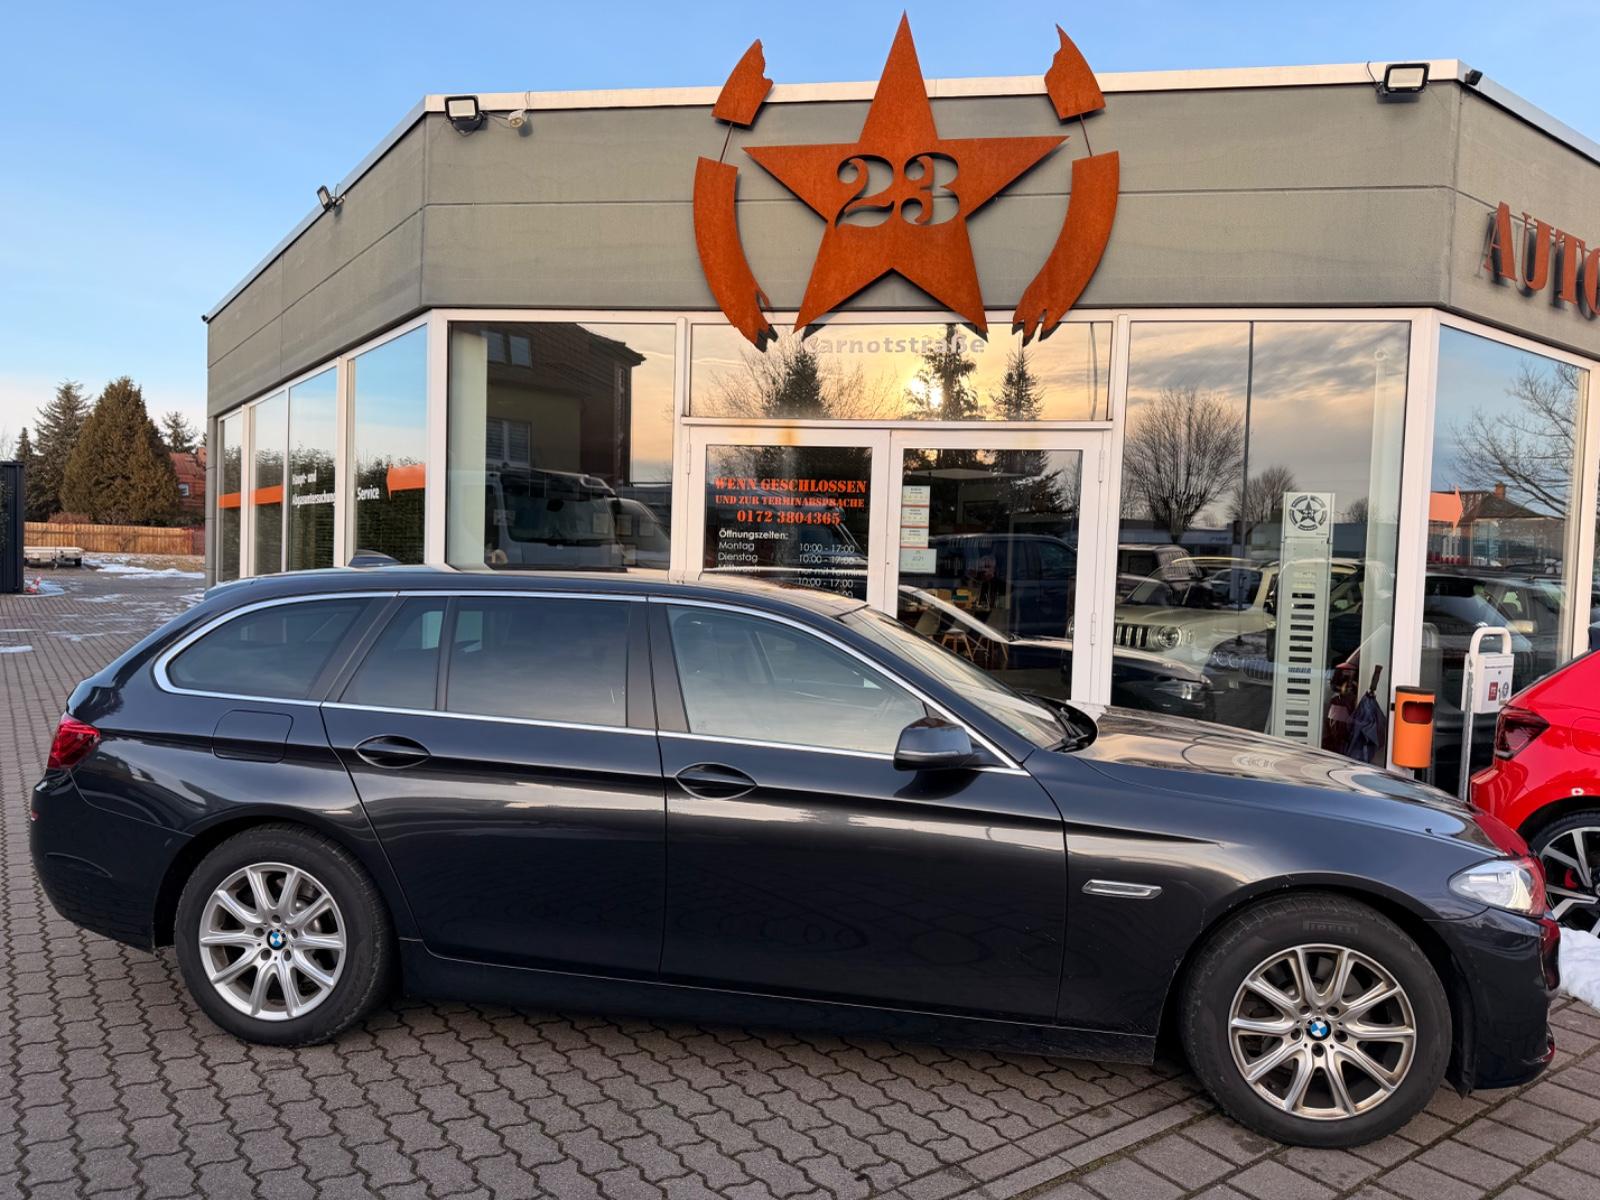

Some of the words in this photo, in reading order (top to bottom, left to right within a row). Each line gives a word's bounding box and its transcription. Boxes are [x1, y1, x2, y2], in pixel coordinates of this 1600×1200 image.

[835, 152, 960, 228] 23
[714, 477, 757, 490] WENN
[760, 479, 867, 493] GESCHLOSSEN
[356, 484, 380, 501] Service
[715, 495, 737, 504] UND
[738, 496, 759, 505] ZUR
[736, 510, 773, 522] 0172
[777, 511, 841, 524] 3804365
[718, 528, 789, 540] Öffnungszeiten:
[718, 541, 755, 552] Montag
[800, 543, 823, 552] 10:00
[831, 544, 856, 553] 17:00
[717, 552, 759, 564] Dienstag
[799, 555, 822, 564] 10:00
[830, 579, 855, 588] 17:00
